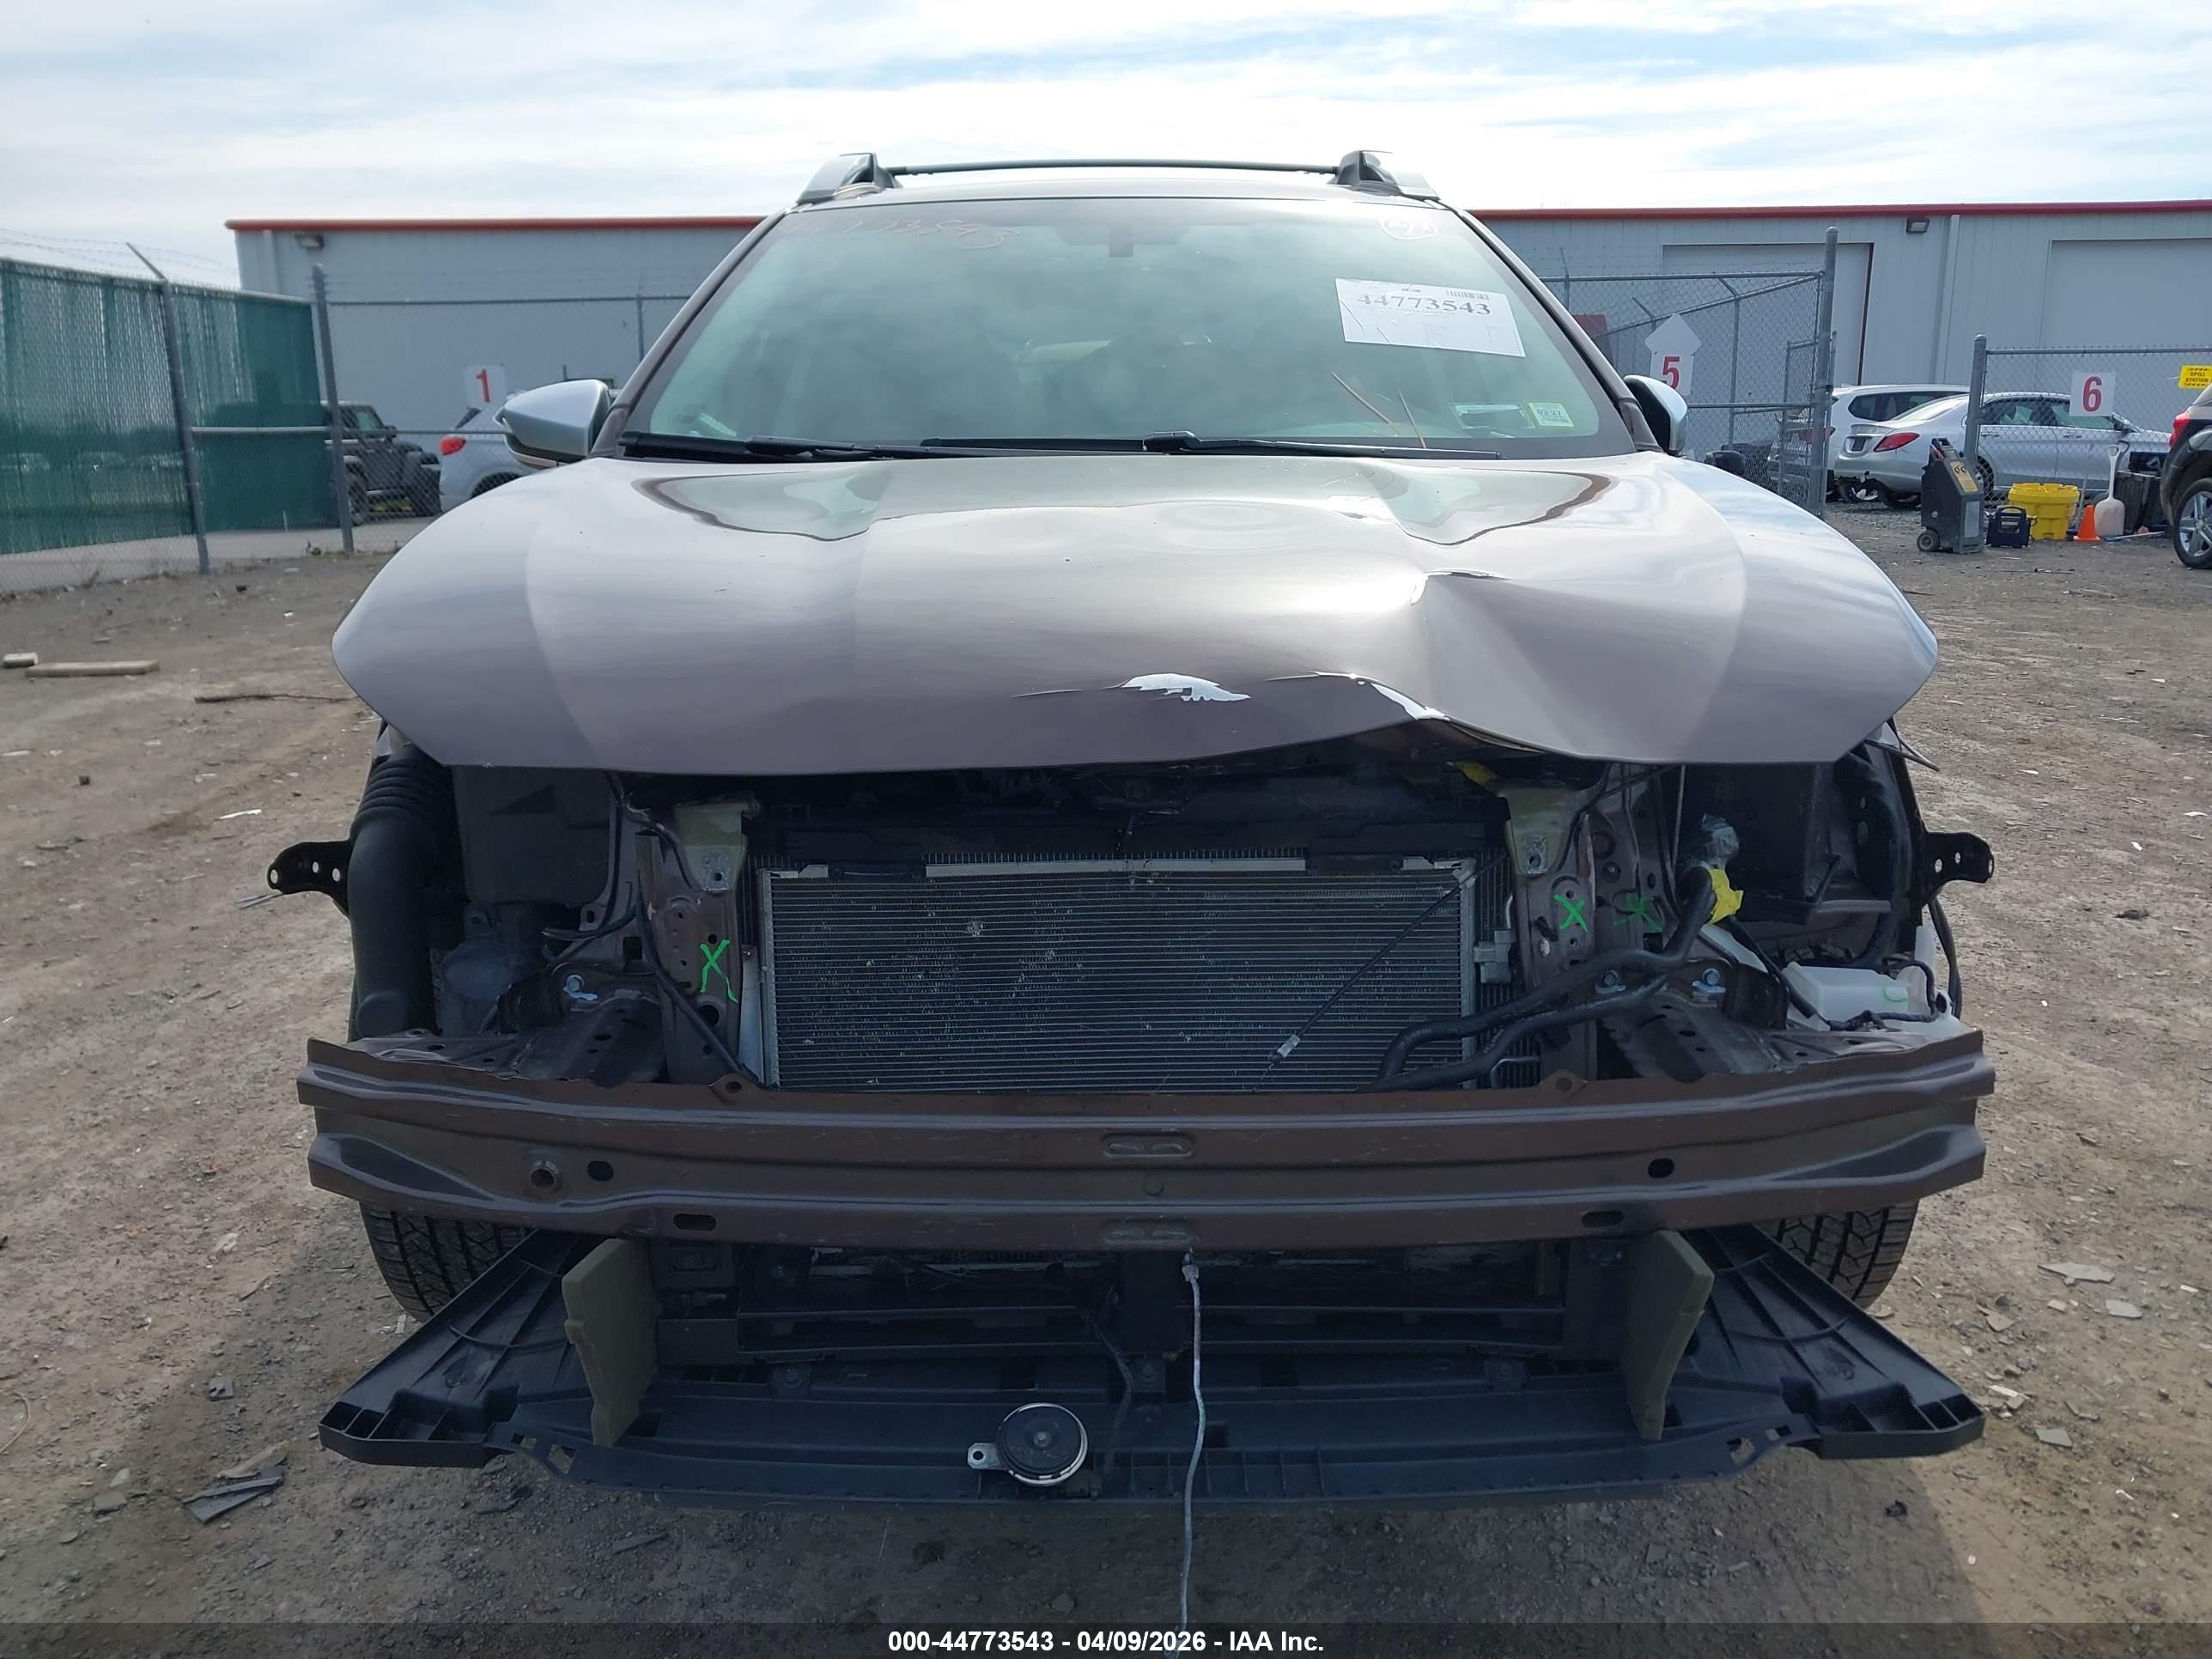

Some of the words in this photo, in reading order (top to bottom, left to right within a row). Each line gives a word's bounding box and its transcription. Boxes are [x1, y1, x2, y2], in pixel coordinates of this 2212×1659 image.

[1357, 295, 1492, 315] 44773543
[476, 368, 491, 403] 1
[1662, 356, 1680, 390] 5
[2082, 376, 2103, 412] 6
